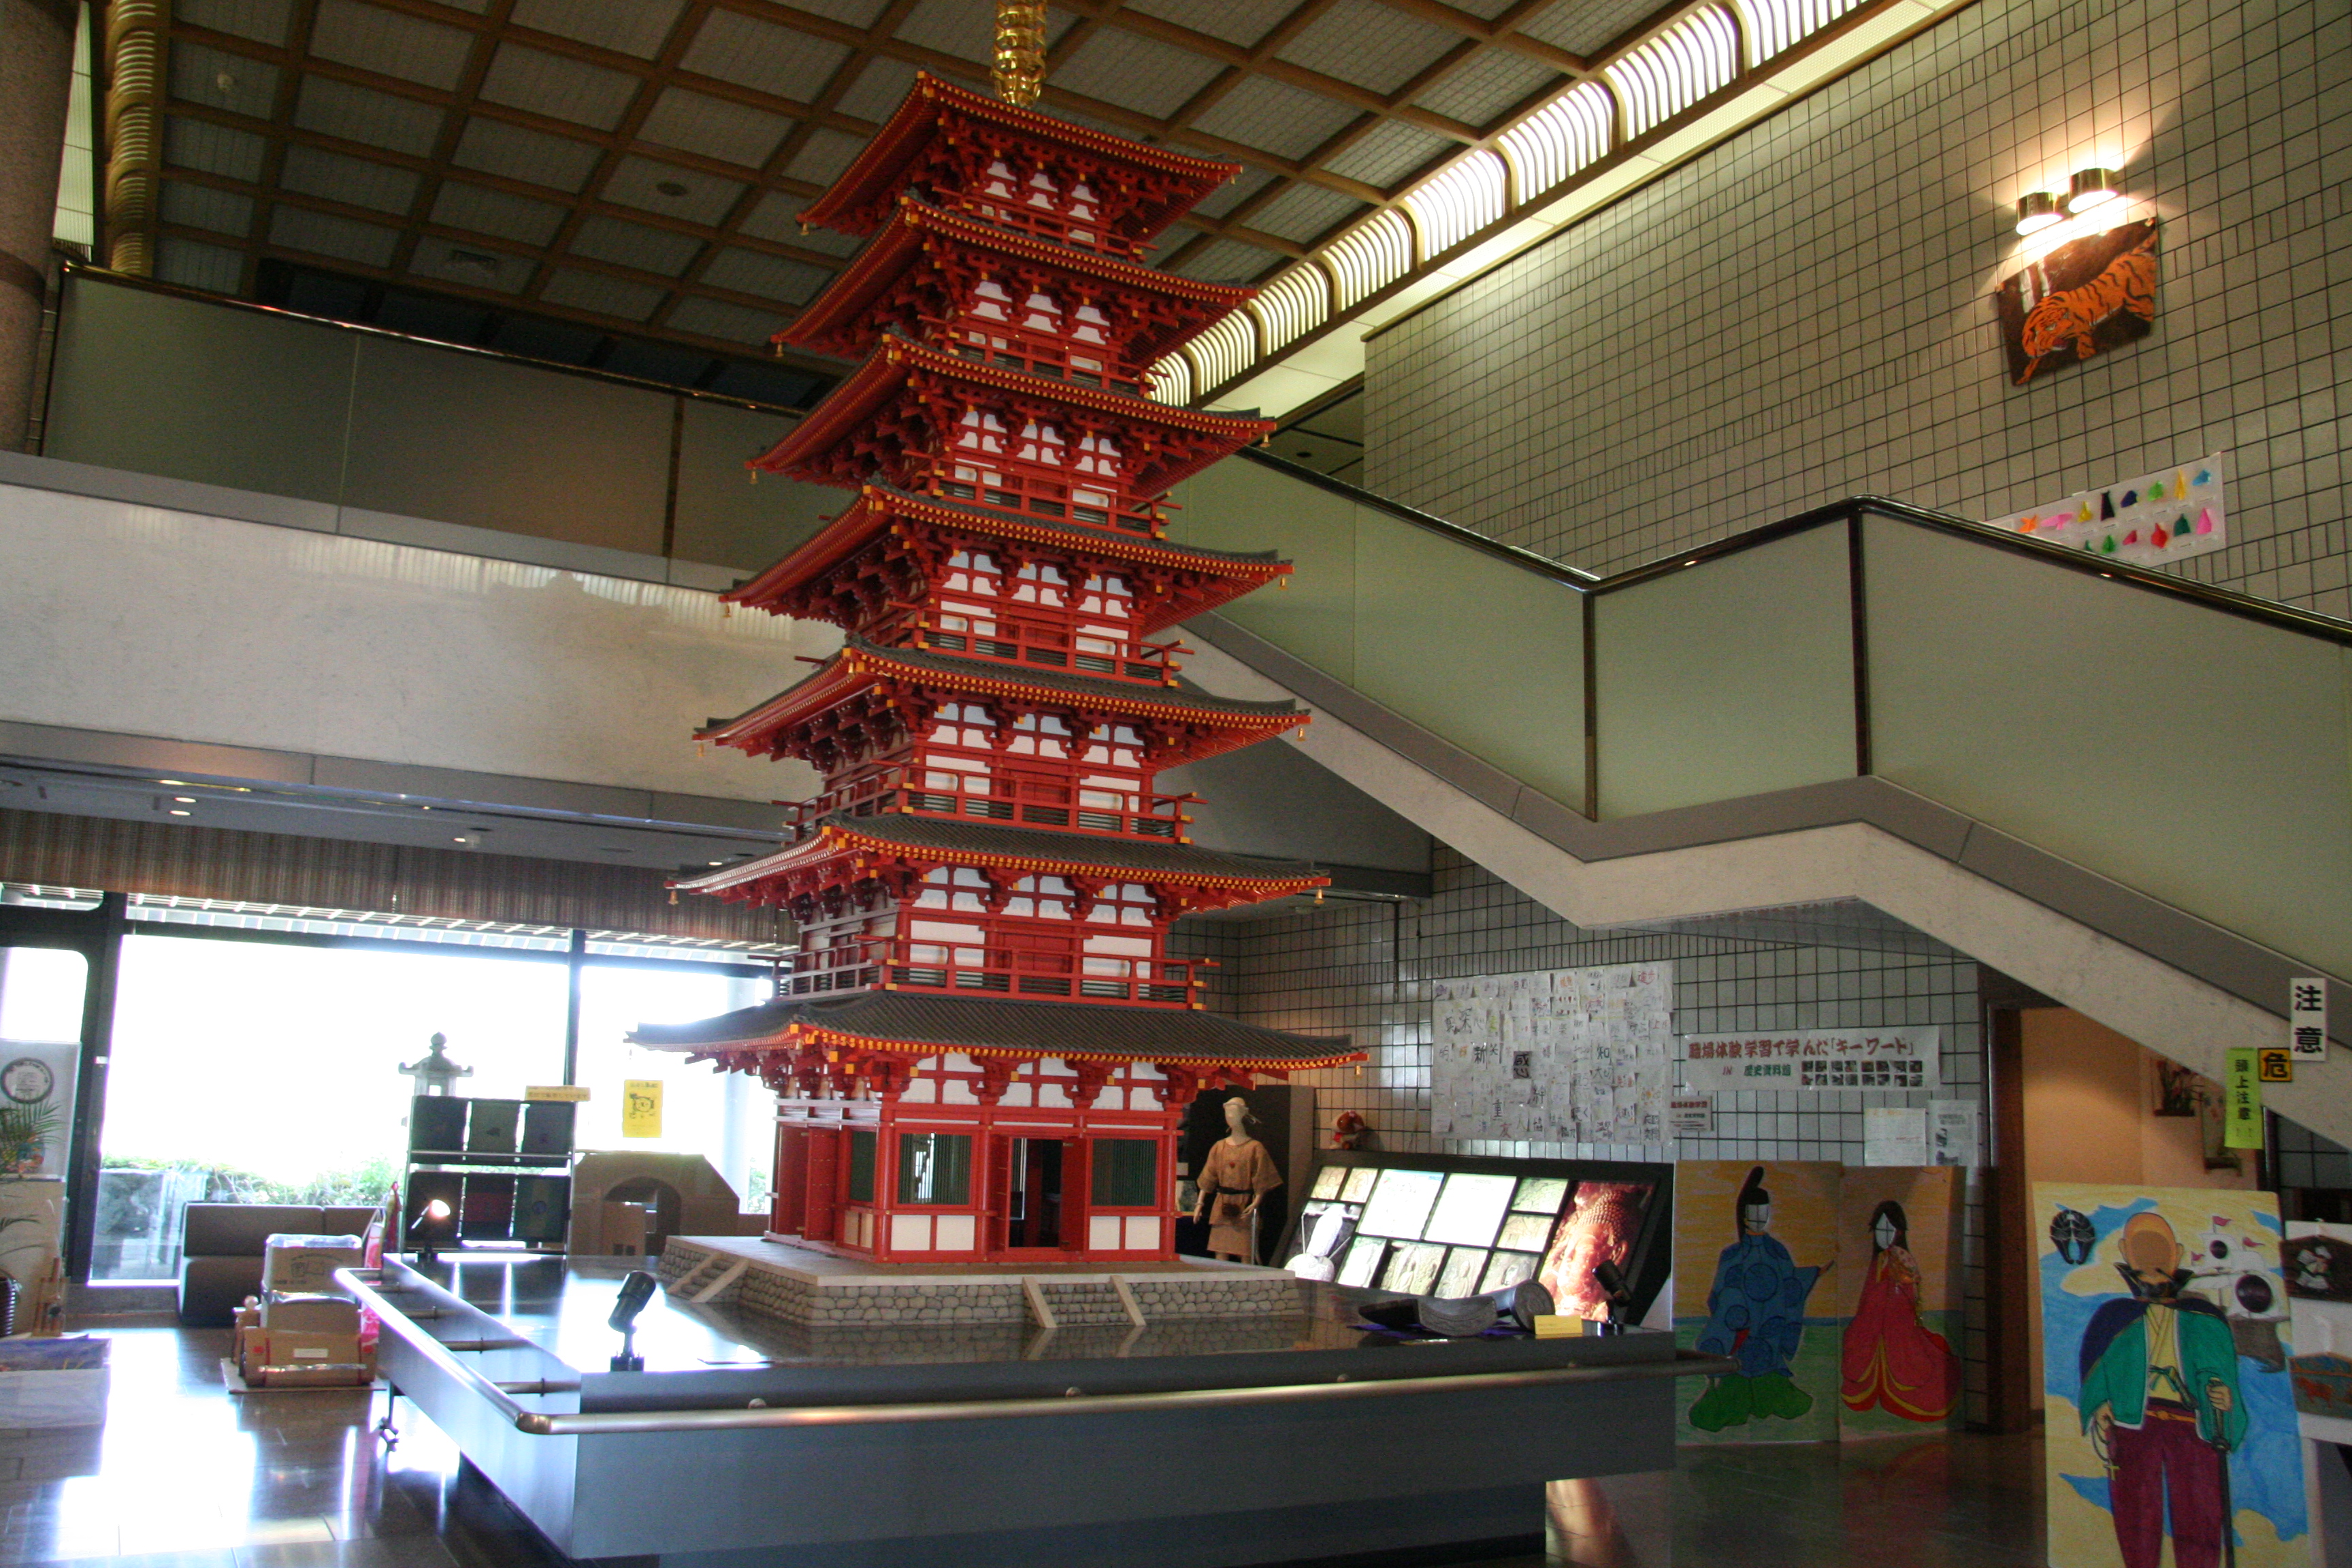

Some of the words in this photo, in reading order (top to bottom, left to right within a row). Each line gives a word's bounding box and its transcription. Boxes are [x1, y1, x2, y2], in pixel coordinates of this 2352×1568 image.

[2294, 984, 2322, 1054] 注意
[1597, 1045, 1610, 1060] 知
[2263, 1052, 2287, 1078] 危
[1514, 1054, 1530, 1079] 感
[1492, 1100, 1503, 1118] 重
